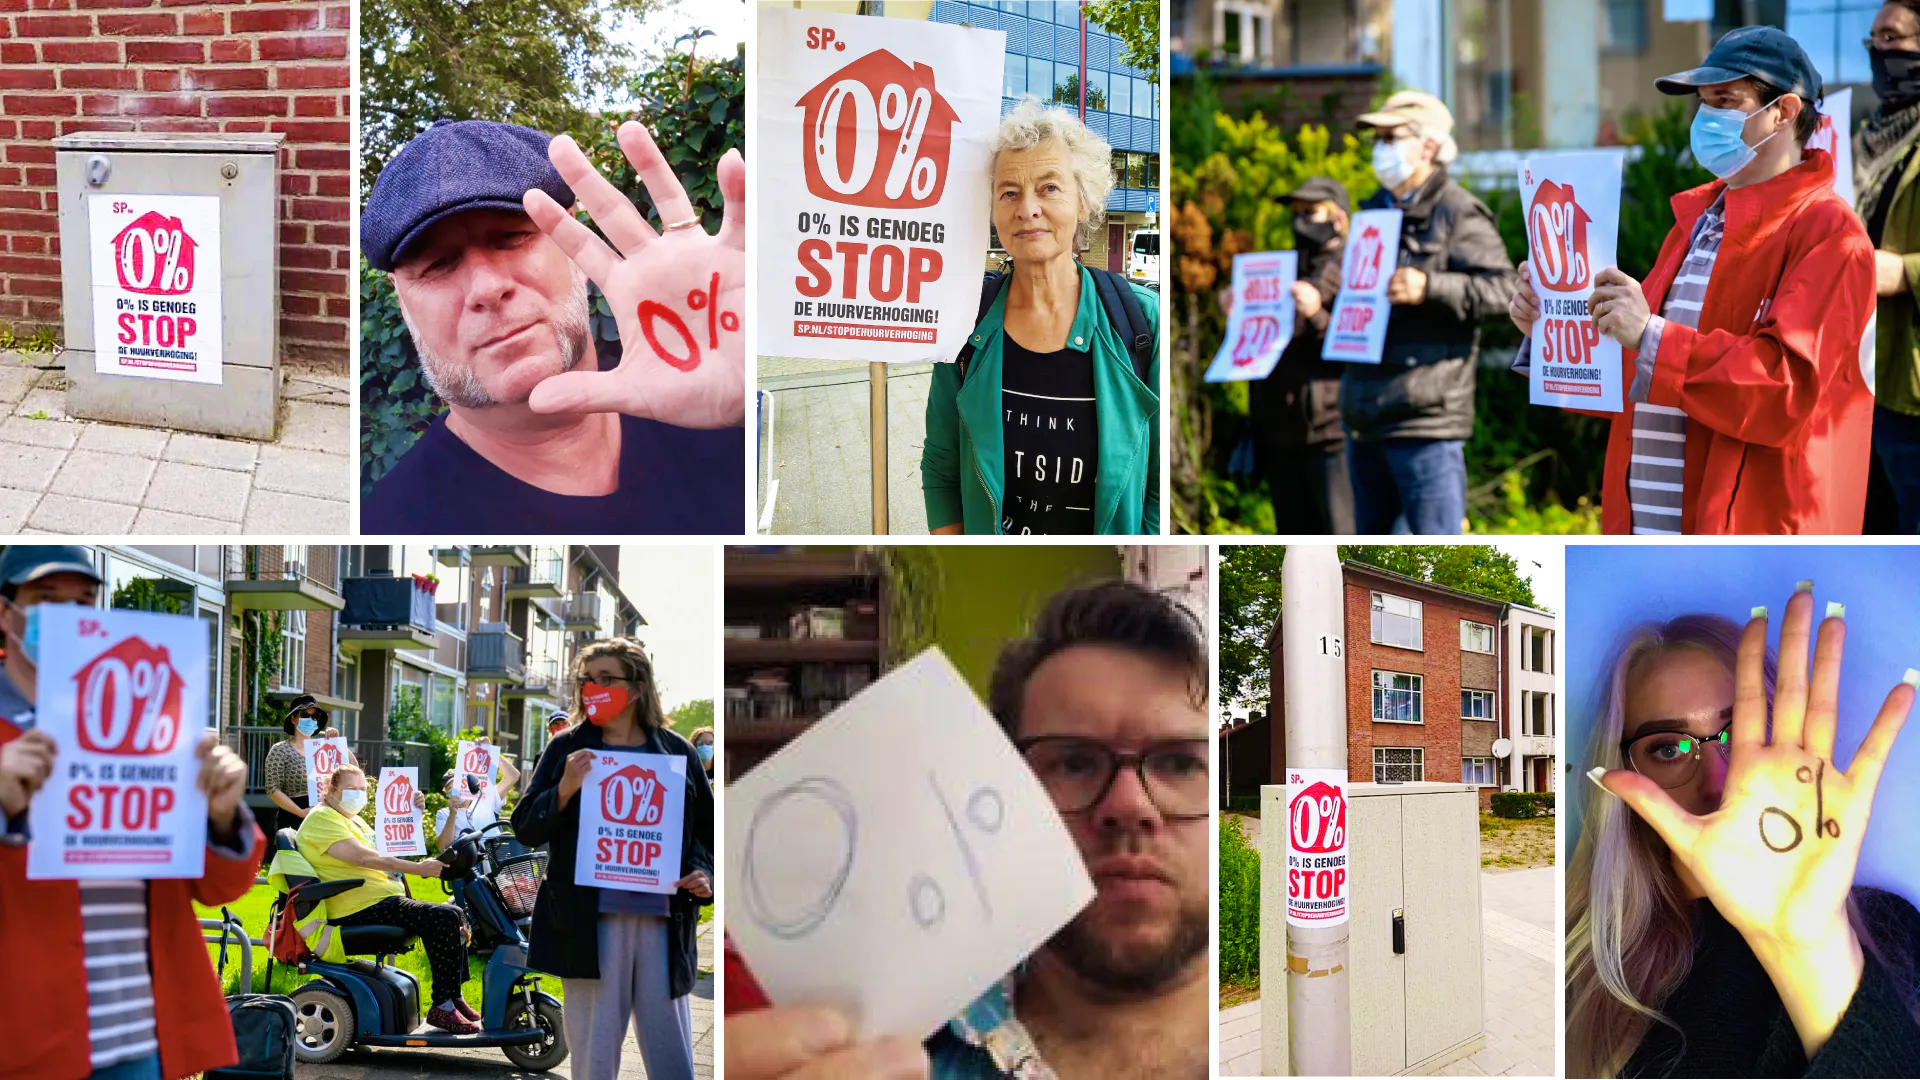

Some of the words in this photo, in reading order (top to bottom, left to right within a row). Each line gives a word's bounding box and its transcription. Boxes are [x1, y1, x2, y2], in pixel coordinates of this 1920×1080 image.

[814, 79, 937, 200] 0%
[798, 212, 831, 235] 0%
[839, 215, 860, 237] IS
[866, 218, 945, 244] GENOEG
[1533, 201, 1585, 286] 0%
[121, 227, 188, 291] 0%
[795, 239, 944, 304] STOP
[116, 298, 134, 310] 0%
[138, 299, 149, 311] IS
[152, 300, 196, 314] GENOEG
[794, 301, 812, 316] DE
[817, 303, 939, 323] HUURVERHOGING!
[1337, 306, 1374, 333] STOP
[1544, 299, 1554, 314] 0%
[1556, 299, 1561, 315] IS
[1563, 300, 1588, 316] GENOE
[118, 312, 197, 348] STOP
[637, 271, 739, 373] 0%
[797, 324, 933, 341] SP.NL/STOPDEHUURVERHOGING
[1542, 318, 1599, 365] STOP
[1542, 365, 1549, 377] DE
[1550, 366, 1601, 380] HUURVERHOGING!
[1006, 409, 1075, 432] THINK
[1014, 450, 1084, 484] TSID
[82, 657, 174, 750] 0%
[466, 751, 488, 774] 0%
[386, 783, 409, 813] 0%
[461, 778, 488, 791] SP
[605, 775, 658, 823] 0%
[66, 784, 176, 831] STOP
[1758, 757, 1841, 853] 0%
[384, 824, 414, 841] STOP
[598, 826, 612, 836] 0%
[616, 828, 625, 838] IS
[627, 829, 663, 841] GENOEG
[1293, 795, 1343, 849] 0%
[595, 837, 662, 867] STOP
[1289, 855, 1300, 868] 0%
[1302, 857, 1312, 868] IS
[1314, 855, 1346, 869] GENOEG
[1288, 868, 1346, 899] STOP
